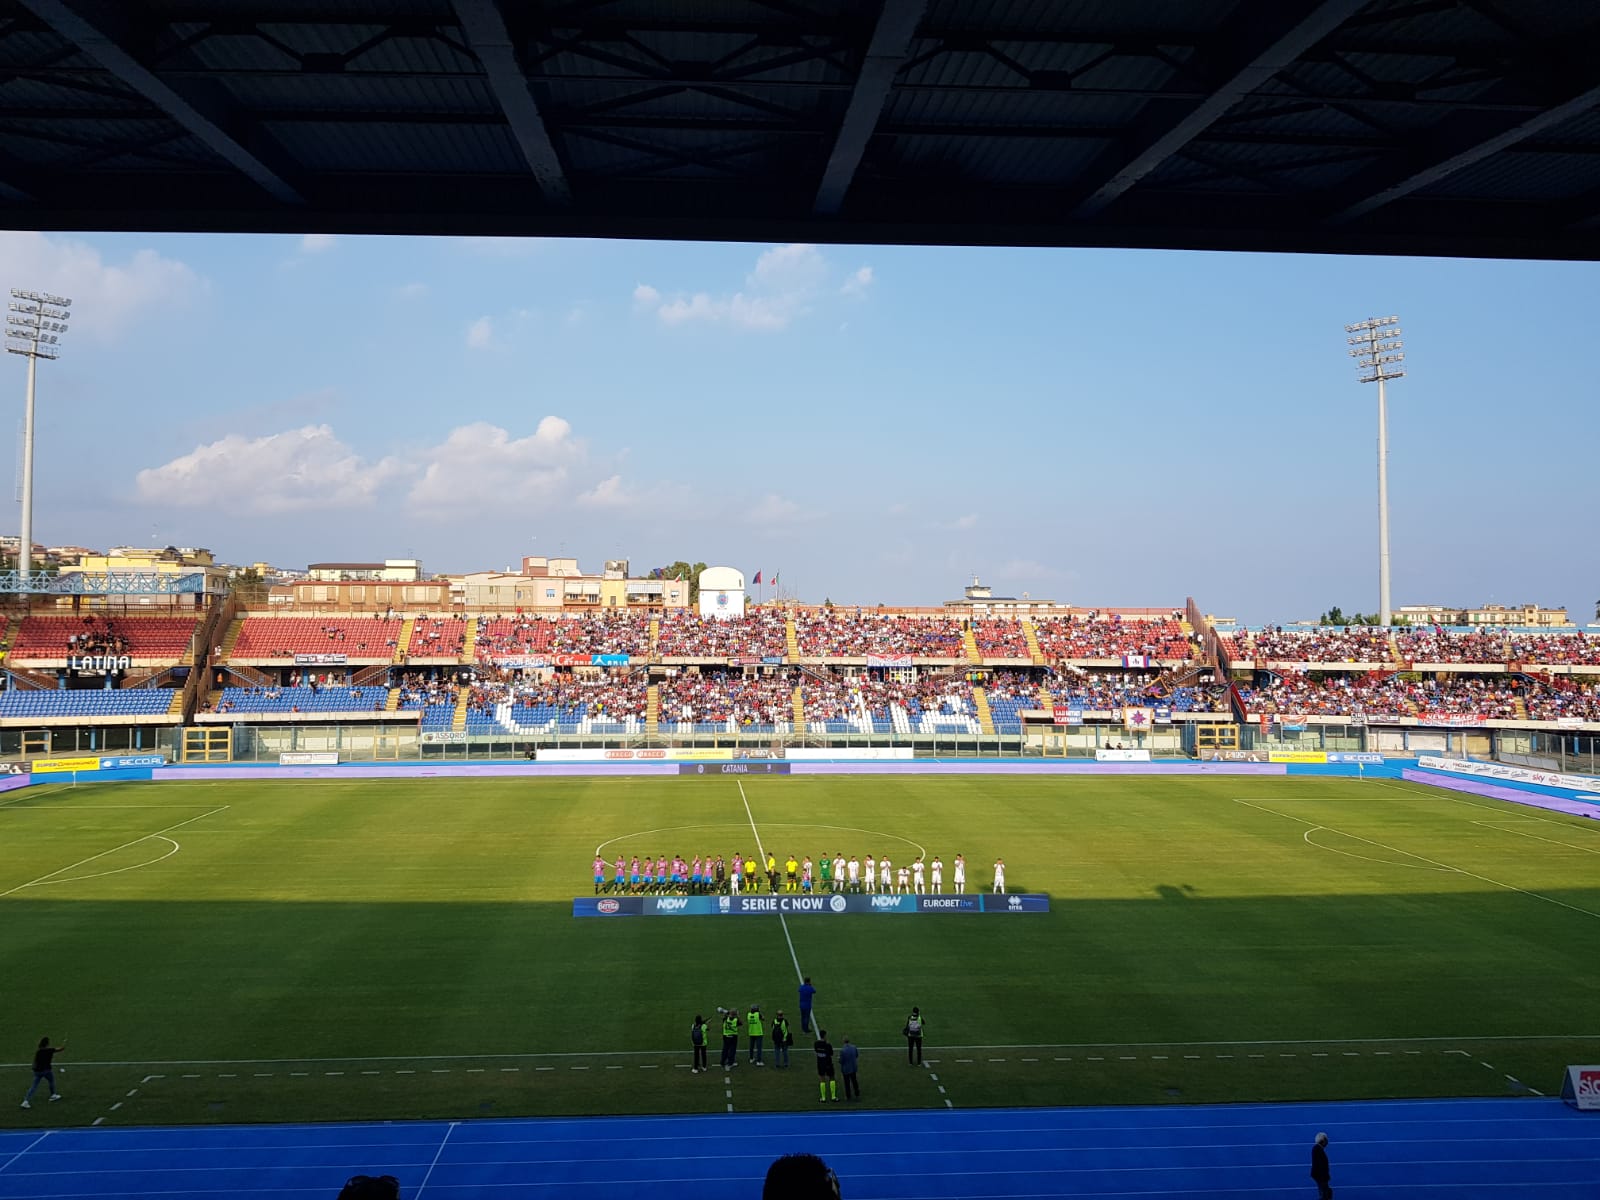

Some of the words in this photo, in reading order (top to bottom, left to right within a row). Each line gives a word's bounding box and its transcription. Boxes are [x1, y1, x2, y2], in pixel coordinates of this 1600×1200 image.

[72, 656, 129, 670] LATINA
[721, 764, 748, 773] CATANIA
[1531, 773, 1546, 783] sky
[656, 898, 689, 909] NOW
[741, 898, 777, 910] SERIE
[780, 898, 789, 910] C
[792, 897, 823, 910] NOW
[871, 896, 902, 907] NOW
